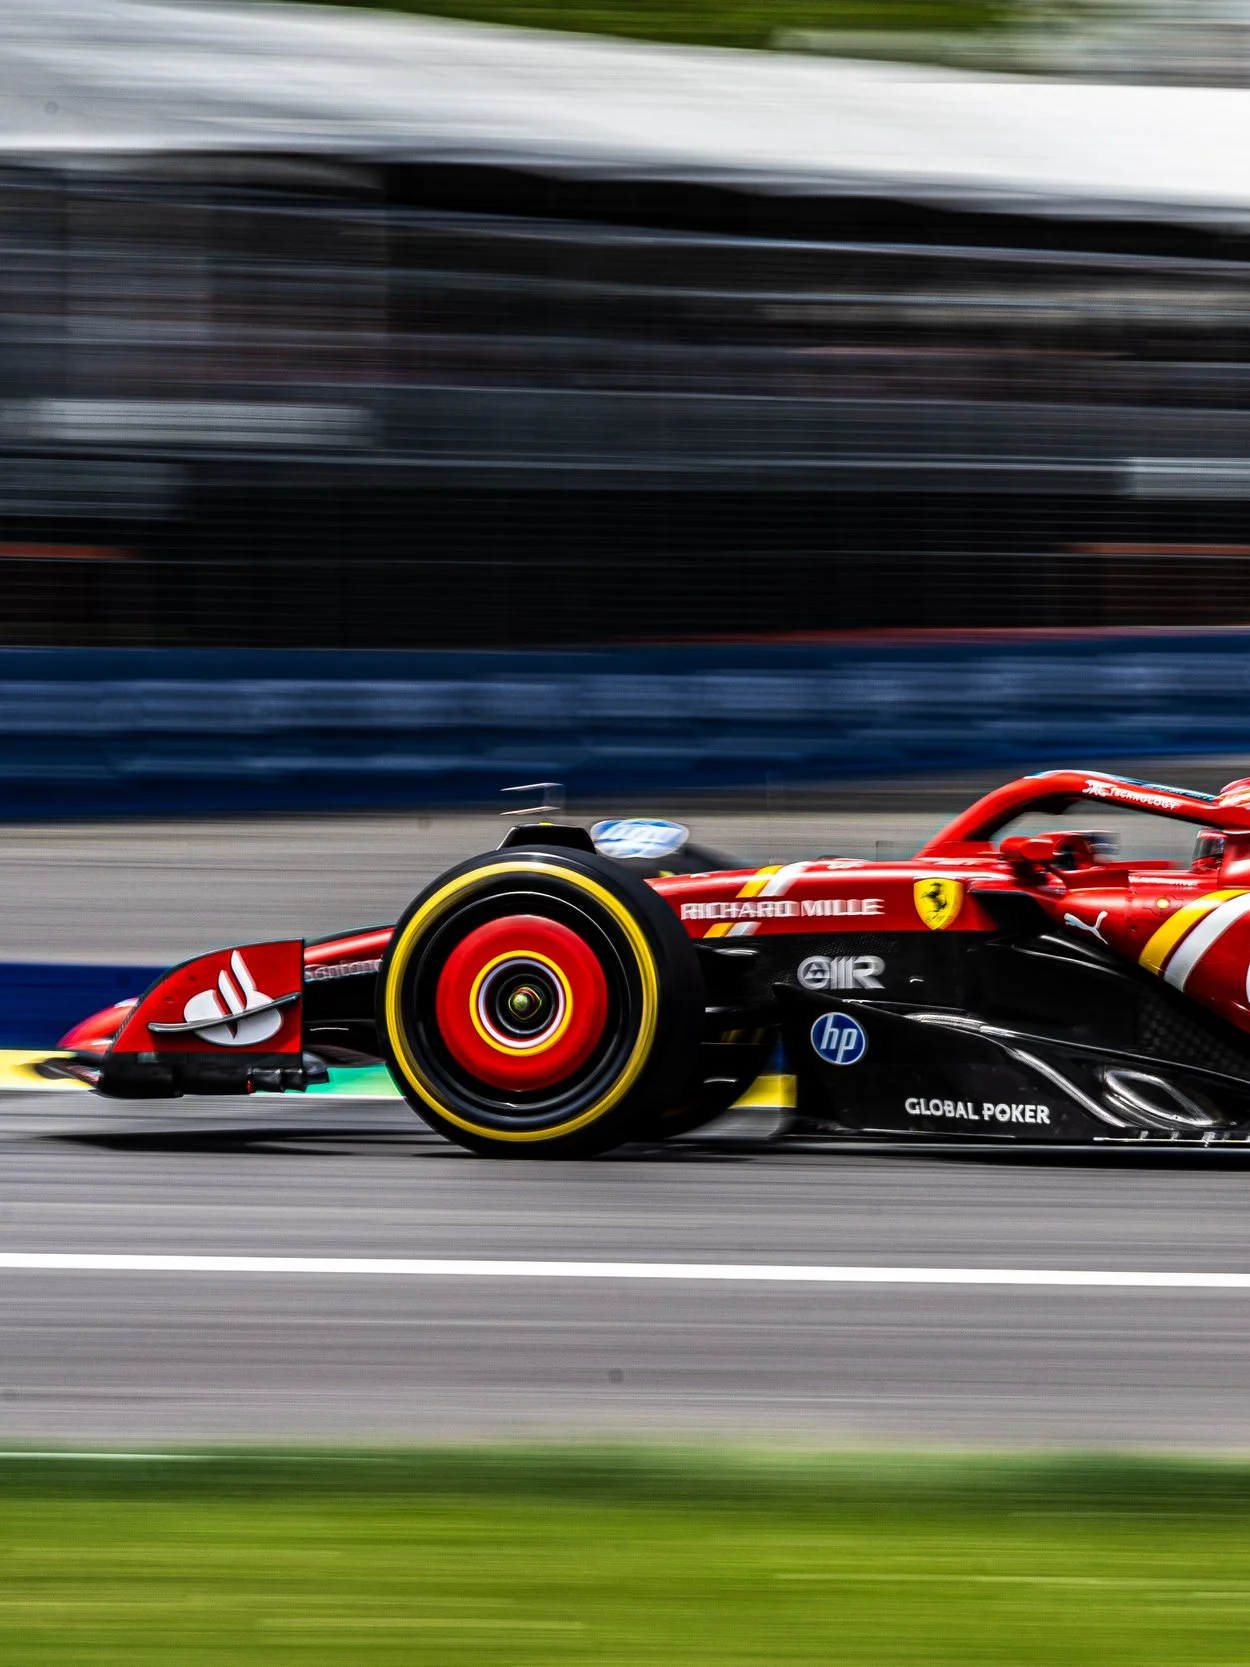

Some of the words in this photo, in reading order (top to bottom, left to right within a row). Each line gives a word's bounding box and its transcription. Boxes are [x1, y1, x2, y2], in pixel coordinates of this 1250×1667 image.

[680, 901, 800, 919] RICHARD
[801, 898, 885, 917] MILLE
[819, 1013, 858, 1064] hp
[905, 1097, 979, 1120] GLOBAL
[982, 1102, 1050, 1125] POKER
